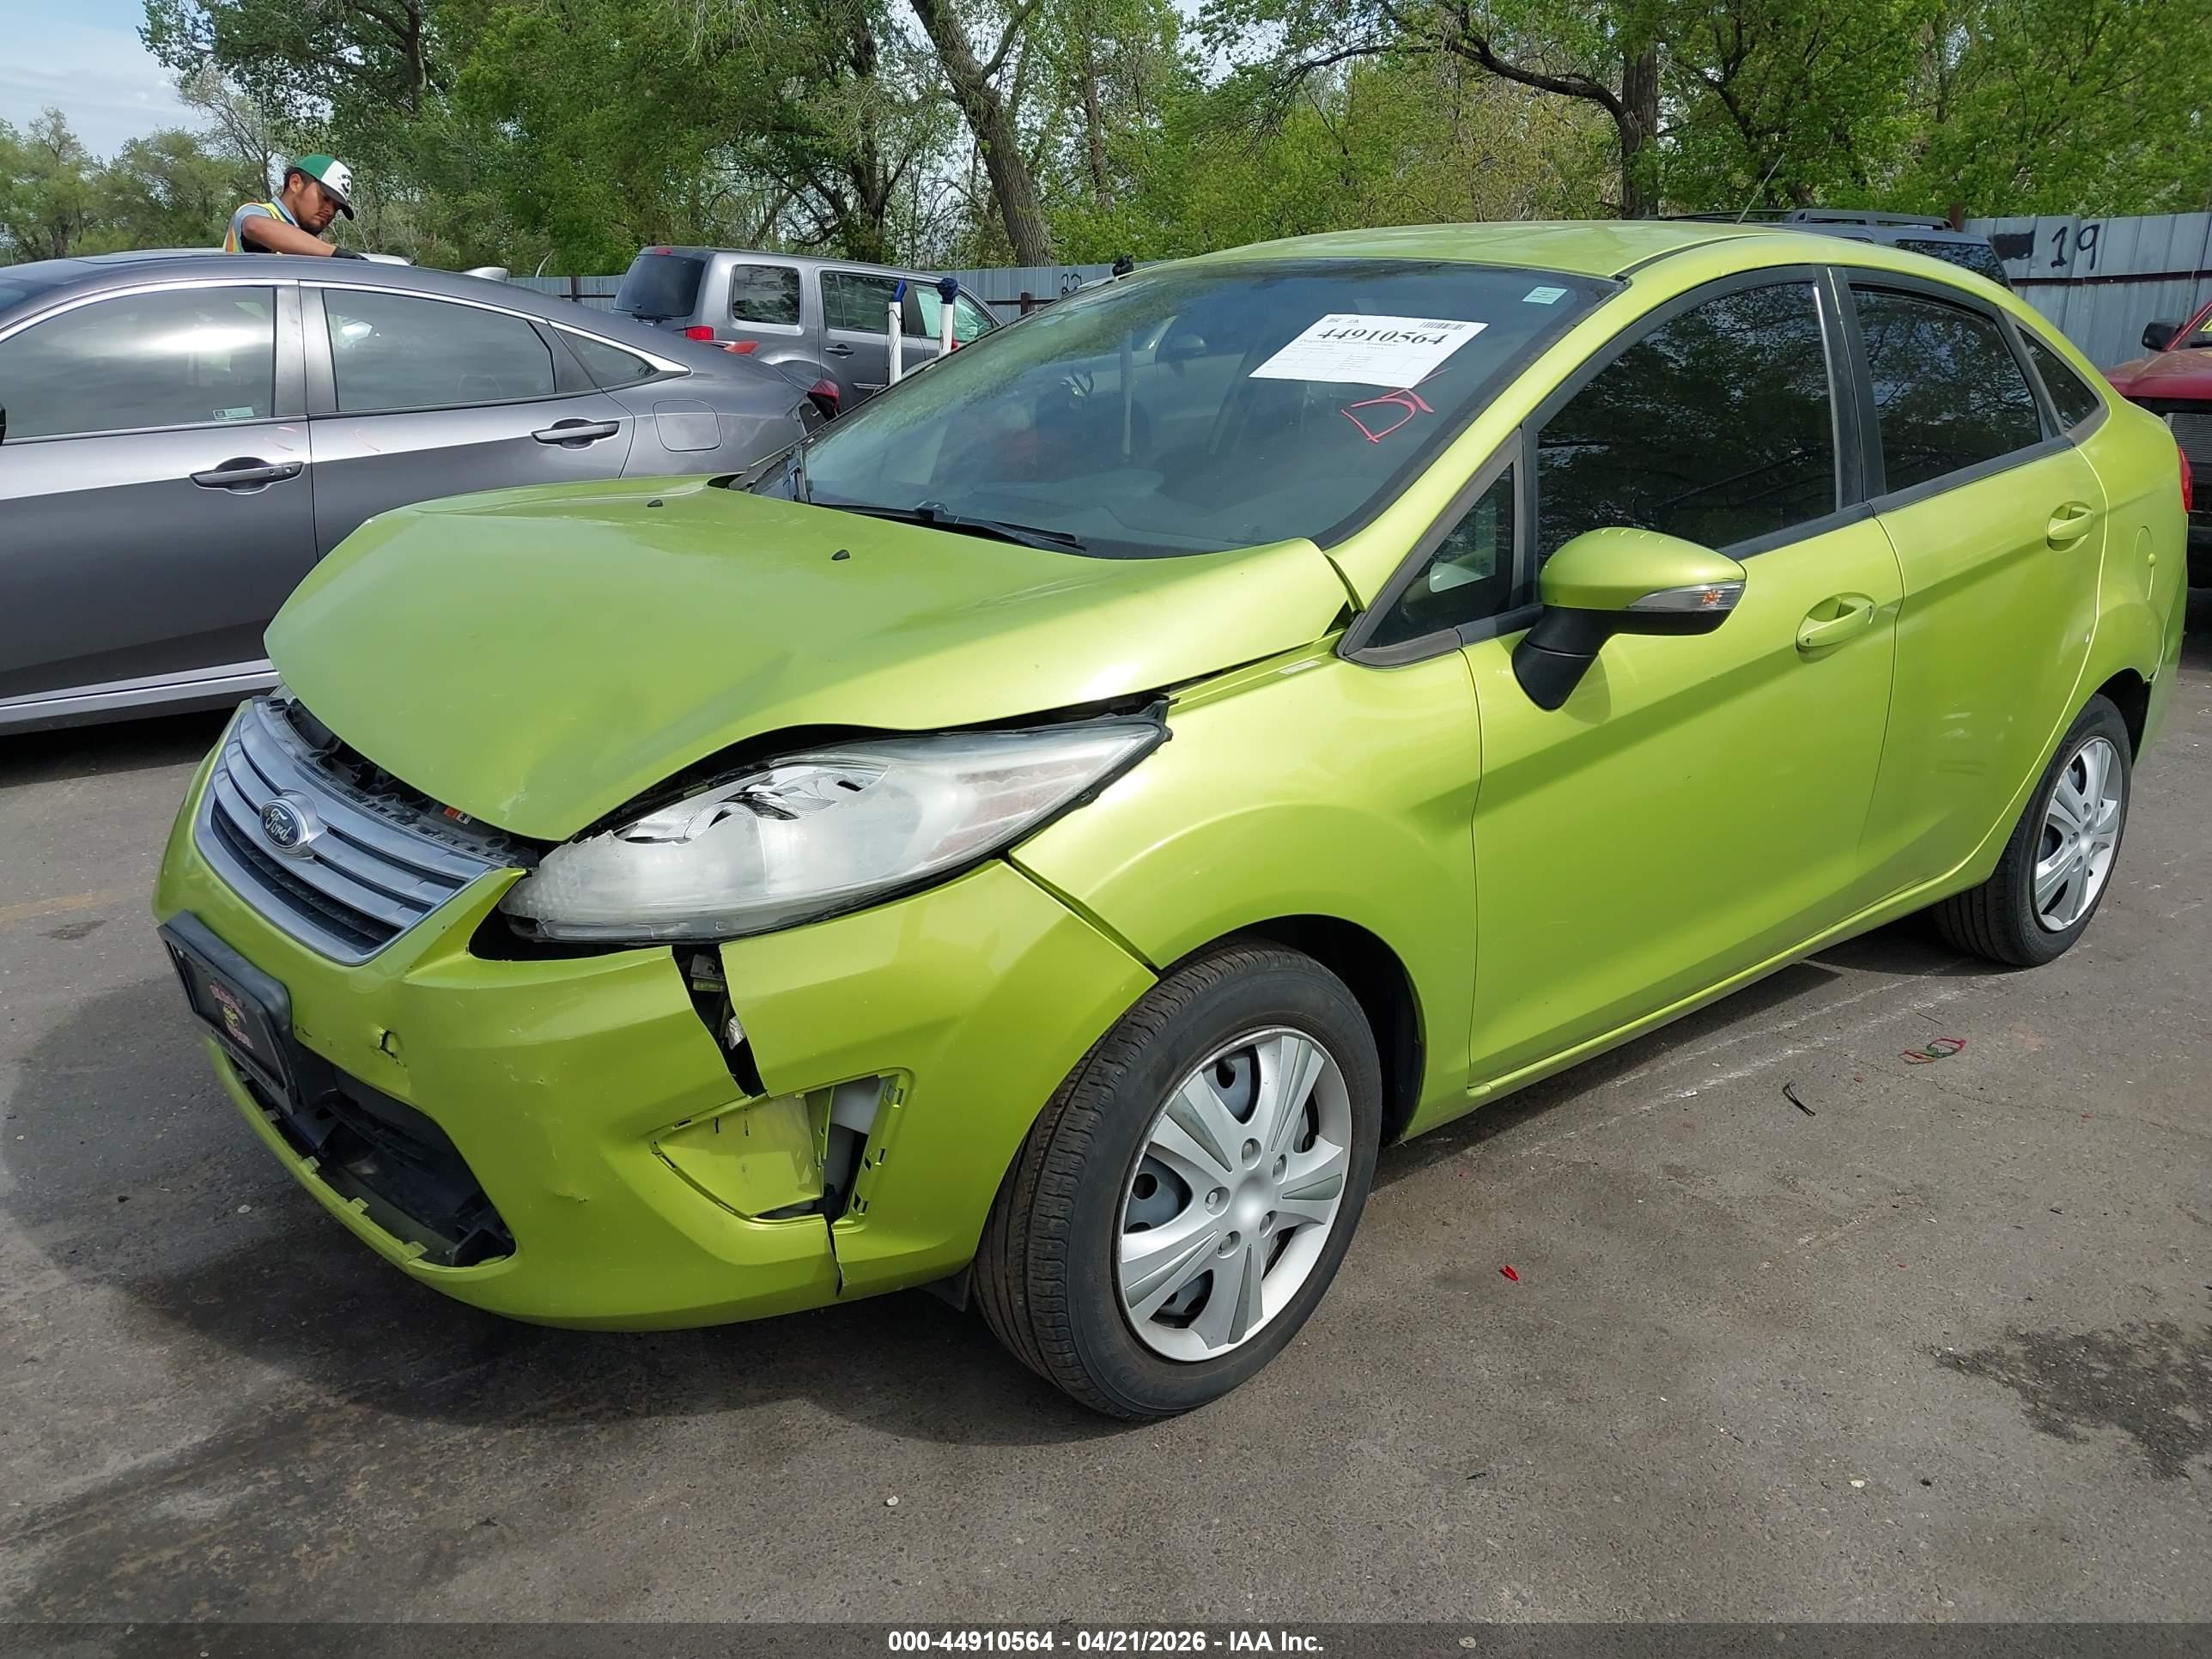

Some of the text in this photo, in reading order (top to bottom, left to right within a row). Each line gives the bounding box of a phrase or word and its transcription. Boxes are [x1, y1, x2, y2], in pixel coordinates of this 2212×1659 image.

[2050, 223, 2100, 271] 19
[1316, 328, 1449, 344] 44910564
[265, 808, 293, 842] Ford
